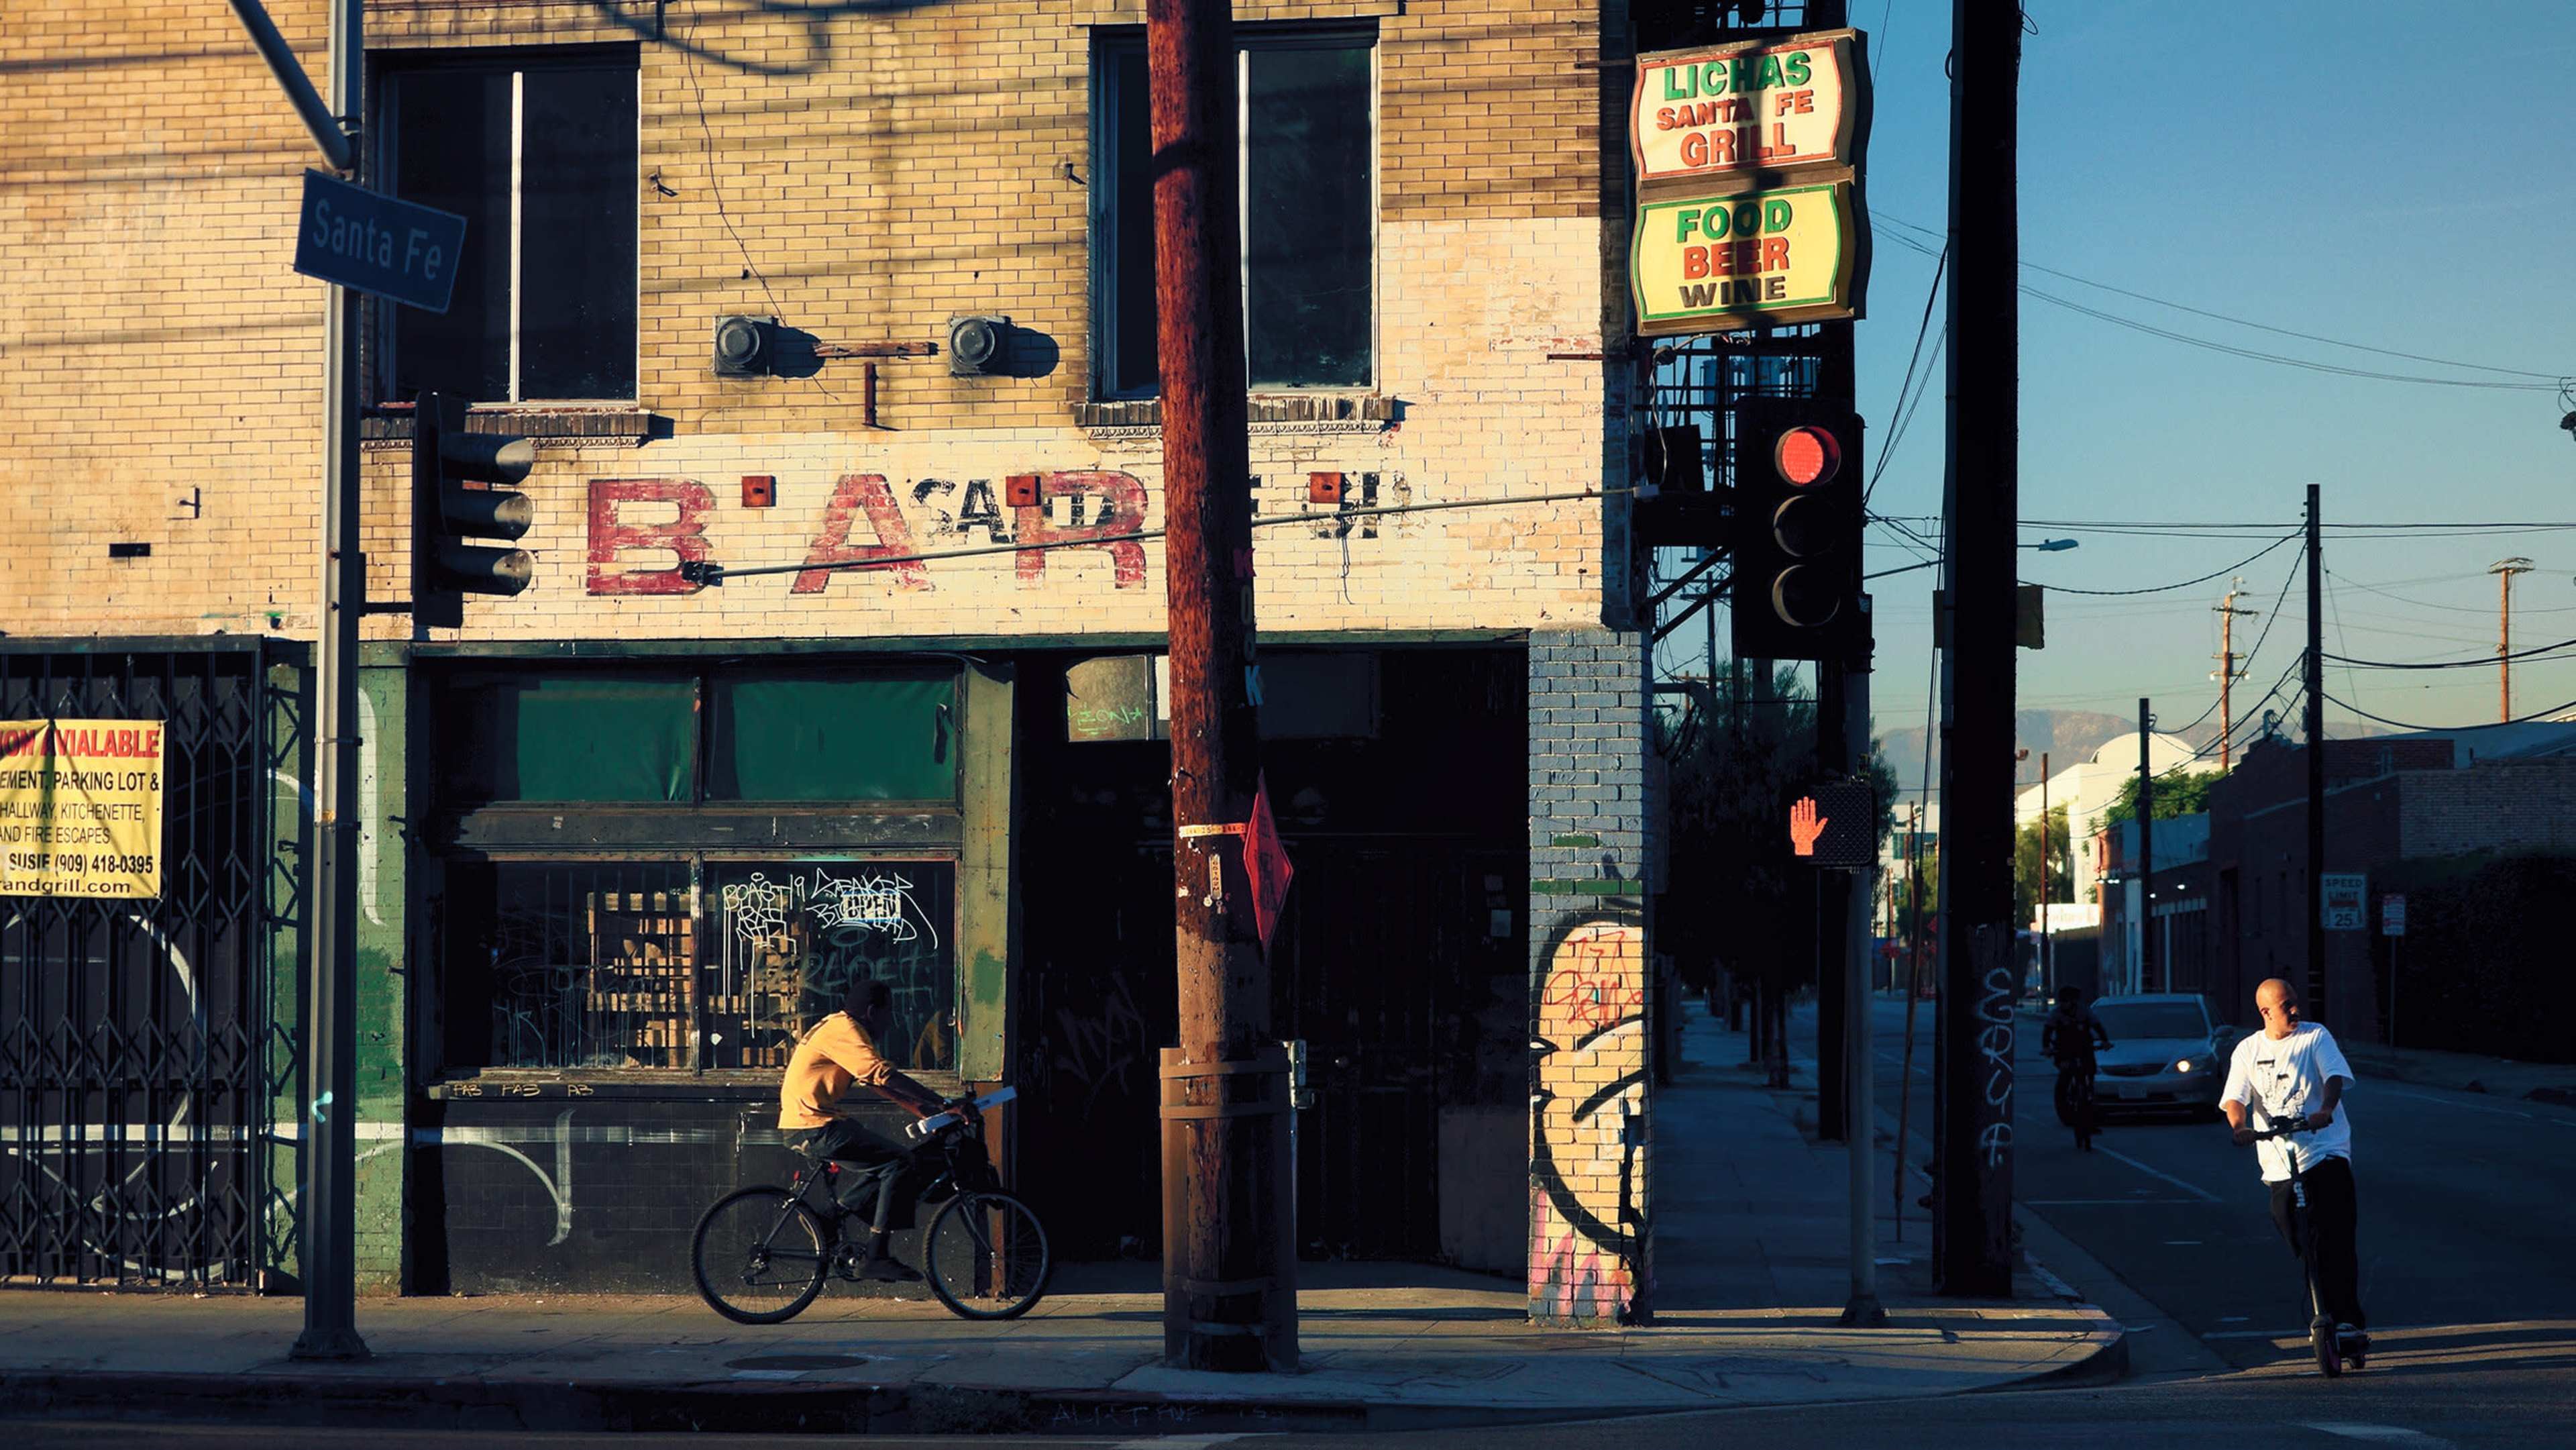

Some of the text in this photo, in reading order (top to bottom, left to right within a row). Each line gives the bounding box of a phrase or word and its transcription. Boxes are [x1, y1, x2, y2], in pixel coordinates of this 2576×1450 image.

[1664, 52, 1811, 101] LICHAS
[1656, 89, 1814, 131] SANTA FE
[1680, 123, 1795, 168] GRILL
[1676, 199, 1792, 243] FOOD
[313, 199, 442, 280] Santa Fe
[1684, 236, 1790, 280] BEER
[1678, 276, 1786, 308] WINE
[40, 729, 160, 758] AVIALABLE
[54, 772, 113, 790] PARKING
[118, 772, 146, 791] LOT
[150, 772, 160, 791] &
[0, 802, 145, 823] HALLWAY, KITCHENETTE,
[25, 827, 52, 843] FIRE
[56, 827, 111, 843] ESCAPES
[54, 854, 87, 876] (909)
[92, 855, 153, 874] 418-0395
[2324, 879, 2363, 887] SPEED
[2328, 891, 2359, 899] LIMIT
[847, 894, 897, 919] OPEN
[2335, 913, 2352, 927] 25
